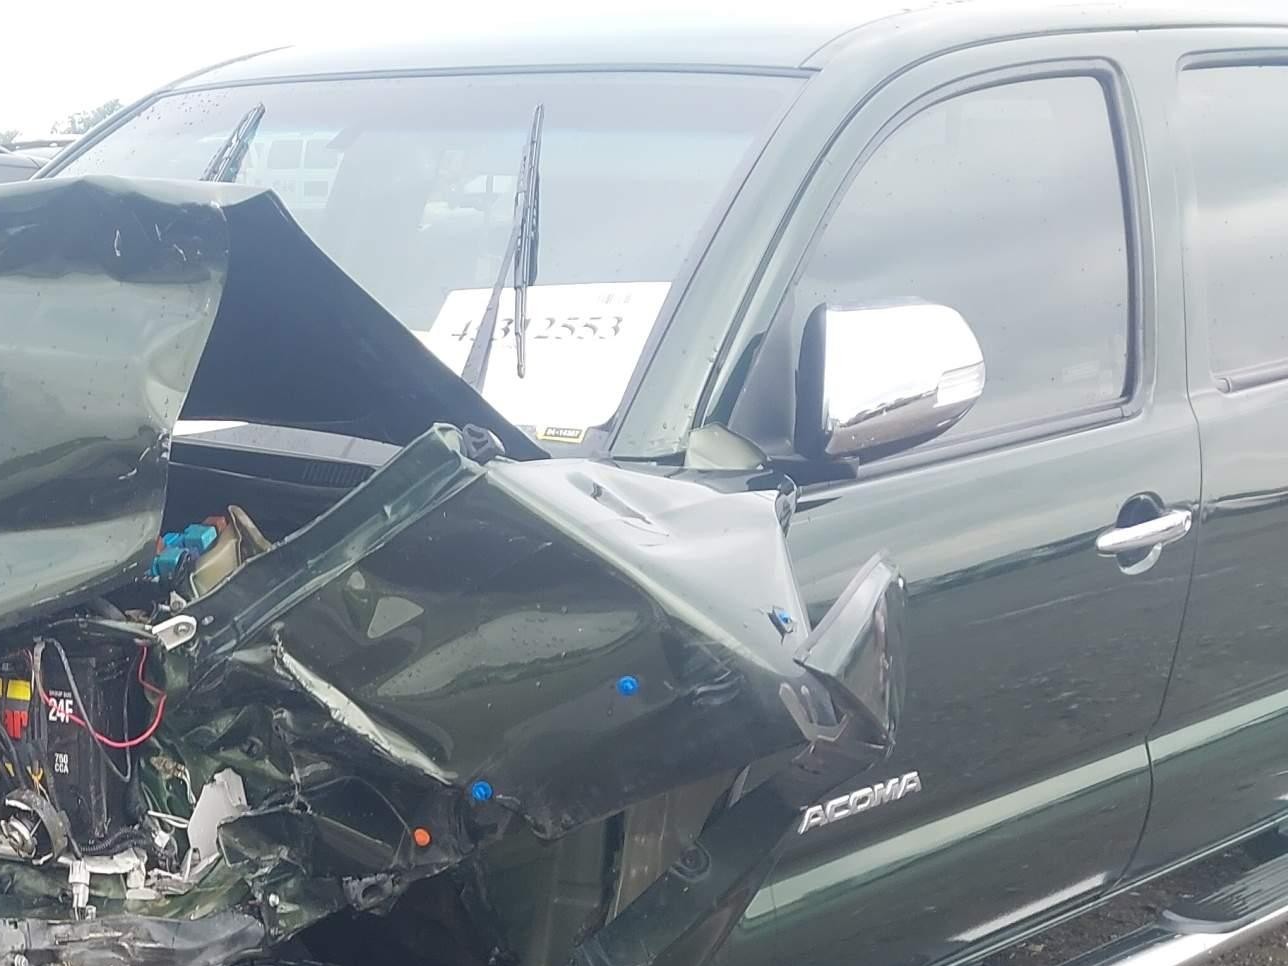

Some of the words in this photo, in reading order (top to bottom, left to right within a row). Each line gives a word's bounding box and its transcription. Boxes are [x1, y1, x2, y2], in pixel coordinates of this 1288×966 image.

[48, 697, 73, 723] 24F
[54, 762, 69, 774] CCA
[797, 771, 922, 835] ACOMA
